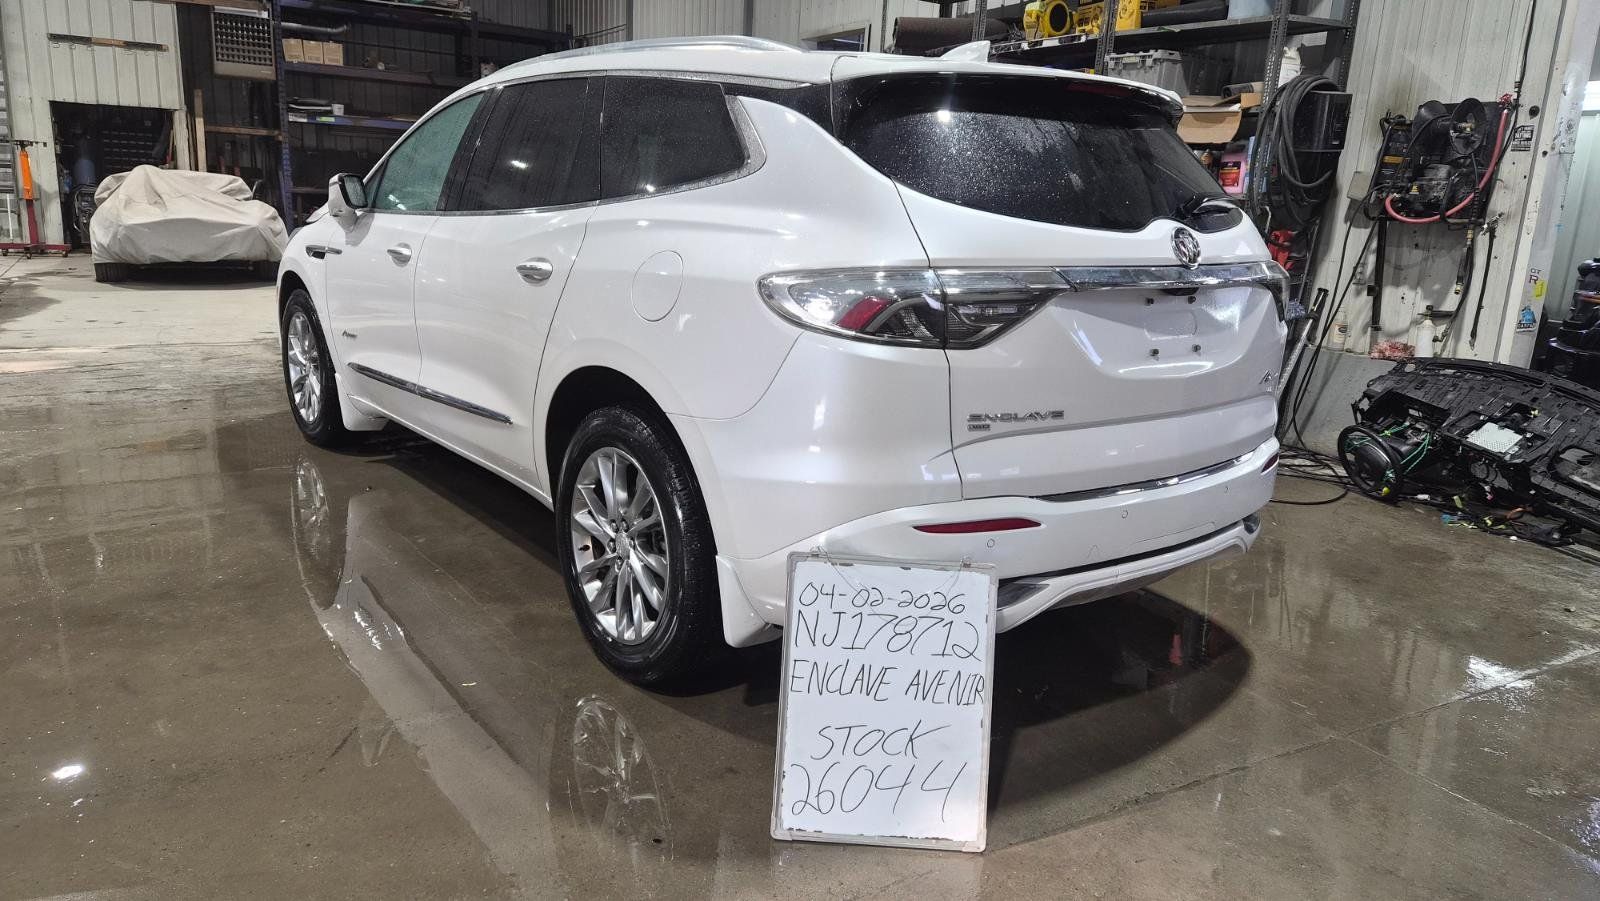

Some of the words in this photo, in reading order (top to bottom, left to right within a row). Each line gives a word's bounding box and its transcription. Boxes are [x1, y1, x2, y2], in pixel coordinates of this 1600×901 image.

[967, 410, 1064, 422] ENCLAVE
[799, 582, 966, 614] 04-02-2026
[795, 610, 982, 662] NJ178712
[790, 659, 898, 701] ENCLAVE
[905, 669, 985, 706] AVENIR
[811, 720, 951, 760] STOCK
[791, 761, 967, 823] 26044
